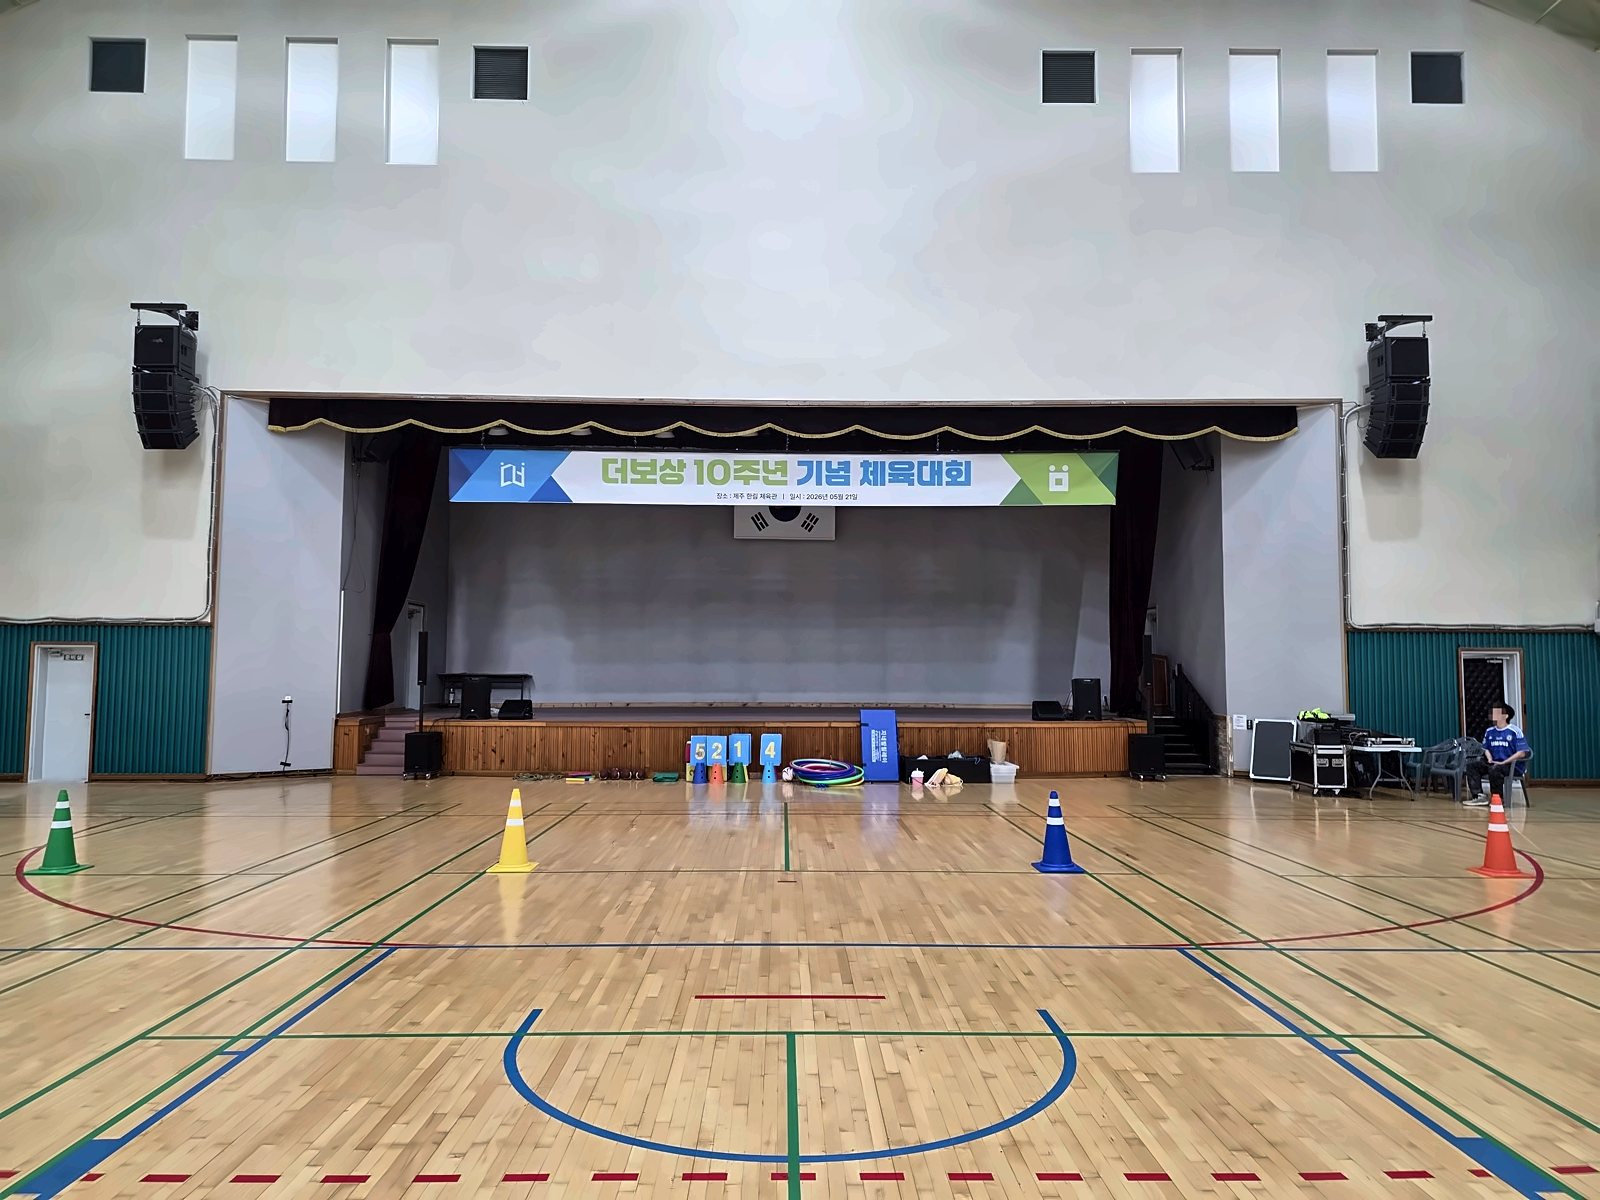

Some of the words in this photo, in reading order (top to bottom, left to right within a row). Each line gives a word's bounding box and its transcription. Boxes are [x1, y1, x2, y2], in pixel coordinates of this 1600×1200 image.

[601, 457, 687, 485] 더보상
[693, 458, 788, 486] 10주년
[796, 459, 851, 487] 기념
[859, 459, 972, 487] 체육대회
[716, 492, 728, 500] 장소
[733, 492, 745, 500] 제주
[759, 492, 778, 500] 체육관
[789, 493, 802, 501] 일시
[806, 493, 828, 501] 2026년
[829, 493, 844, 501] 05월
[845, 493, 858, 501] 21일
[694, 743, 706, 760] 5
[711, 742, 723, 759] 2
[734, 740, 743, 758] 1
[764, 741, 776, 759] 4
